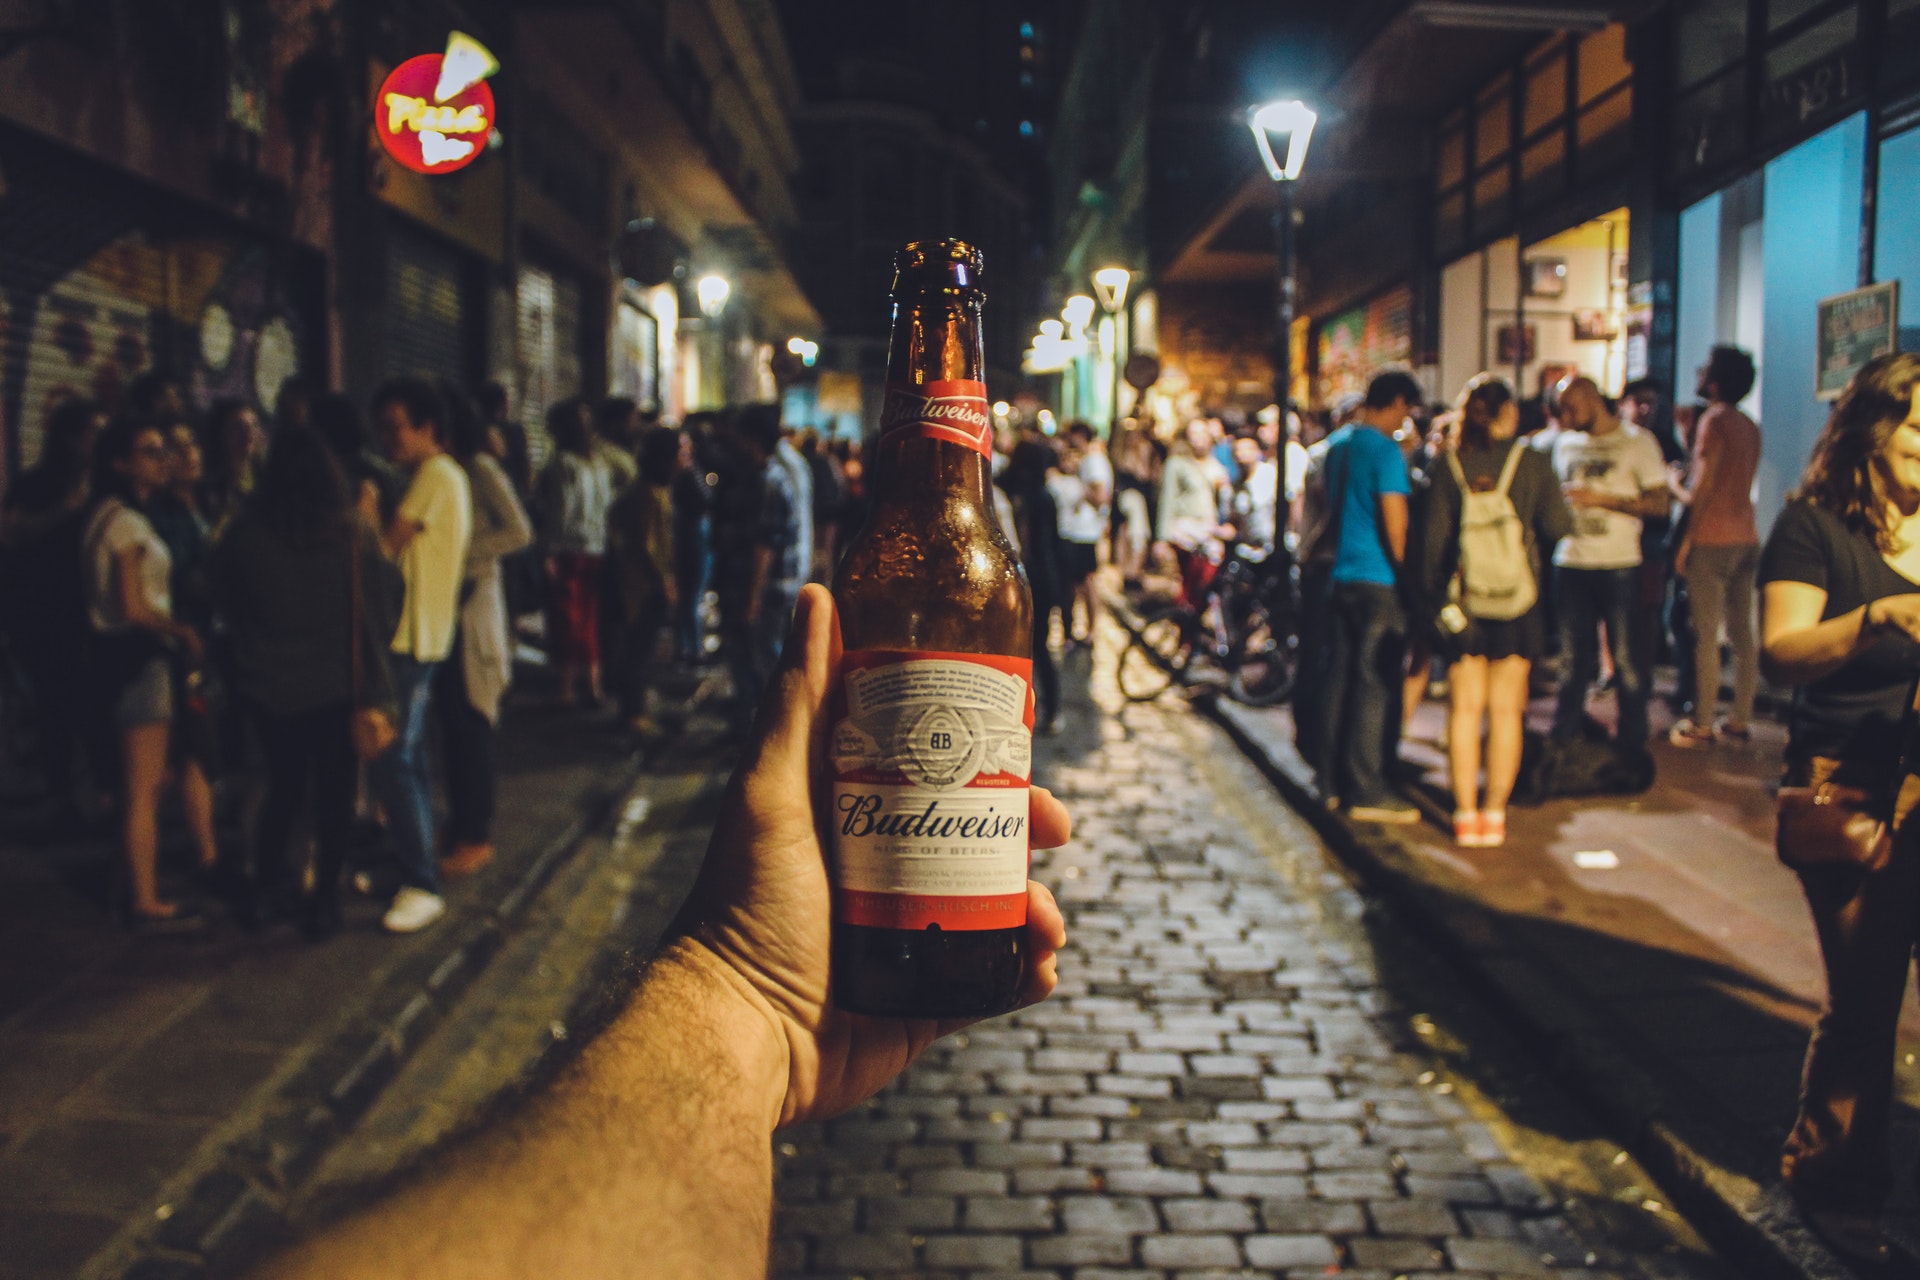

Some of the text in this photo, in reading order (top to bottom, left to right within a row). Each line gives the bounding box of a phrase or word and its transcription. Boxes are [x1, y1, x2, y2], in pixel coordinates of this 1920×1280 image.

[886, 397, 988, 426] Budweiser
[930, 732, 952, 749] AB
[837, 792, 1025, 838] Budweiser
[920, 846, 942, 855] OF
